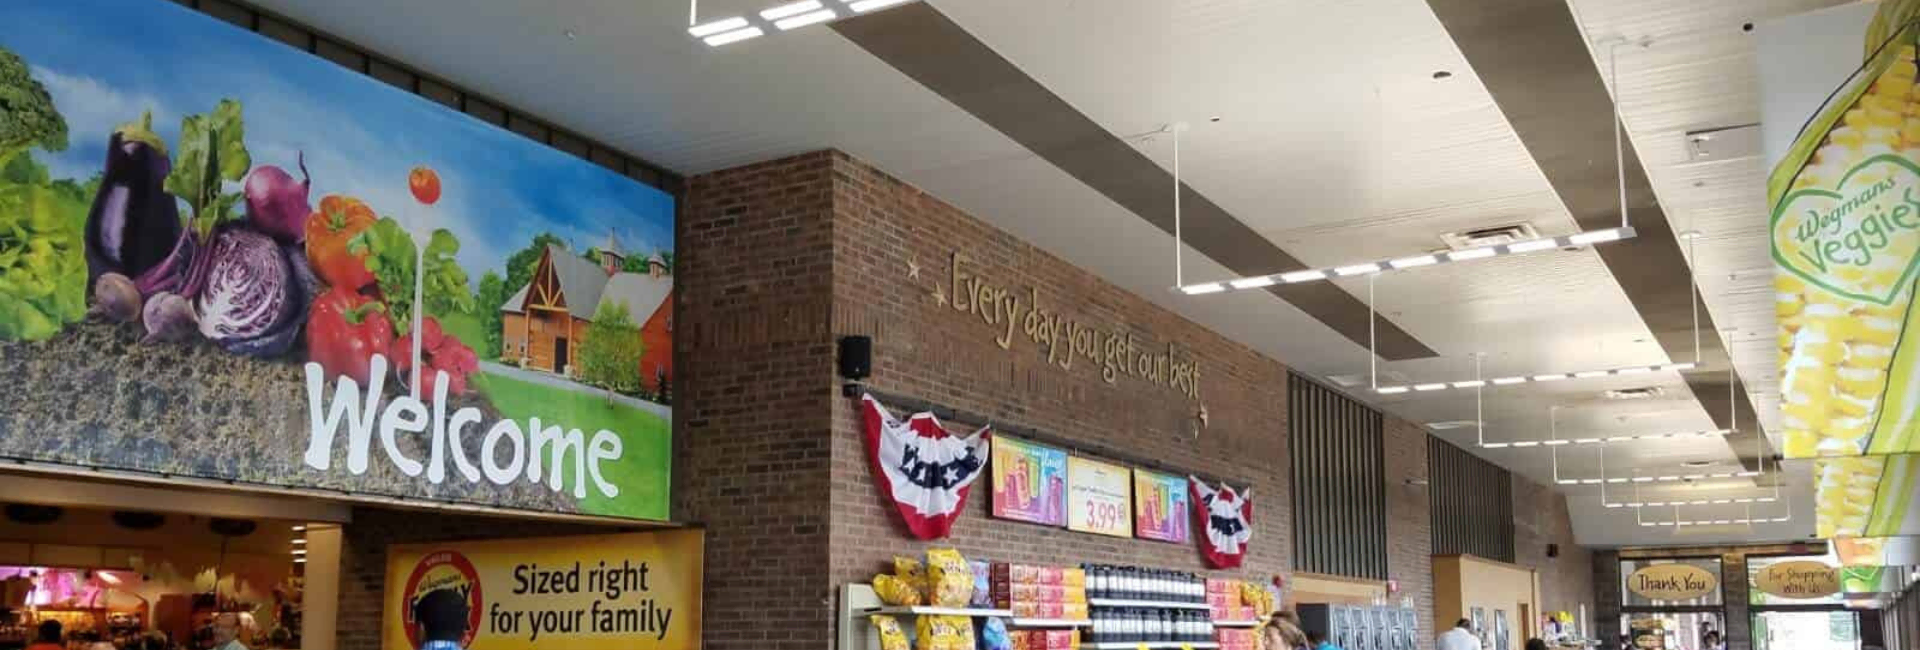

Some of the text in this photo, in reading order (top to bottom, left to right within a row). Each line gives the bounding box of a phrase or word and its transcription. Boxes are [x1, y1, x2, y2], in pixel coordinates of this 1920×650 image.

[1795, 177, 1896, 242] Wegmans
[951, 252, 1200, 400] Every day you get our best
[304, 353, 623, 499] Welcome
[513, 559, 649, 599] Sized right
[1638, 572, 1706, 592] Thank You
[490, 600, 672, 641] for your family
